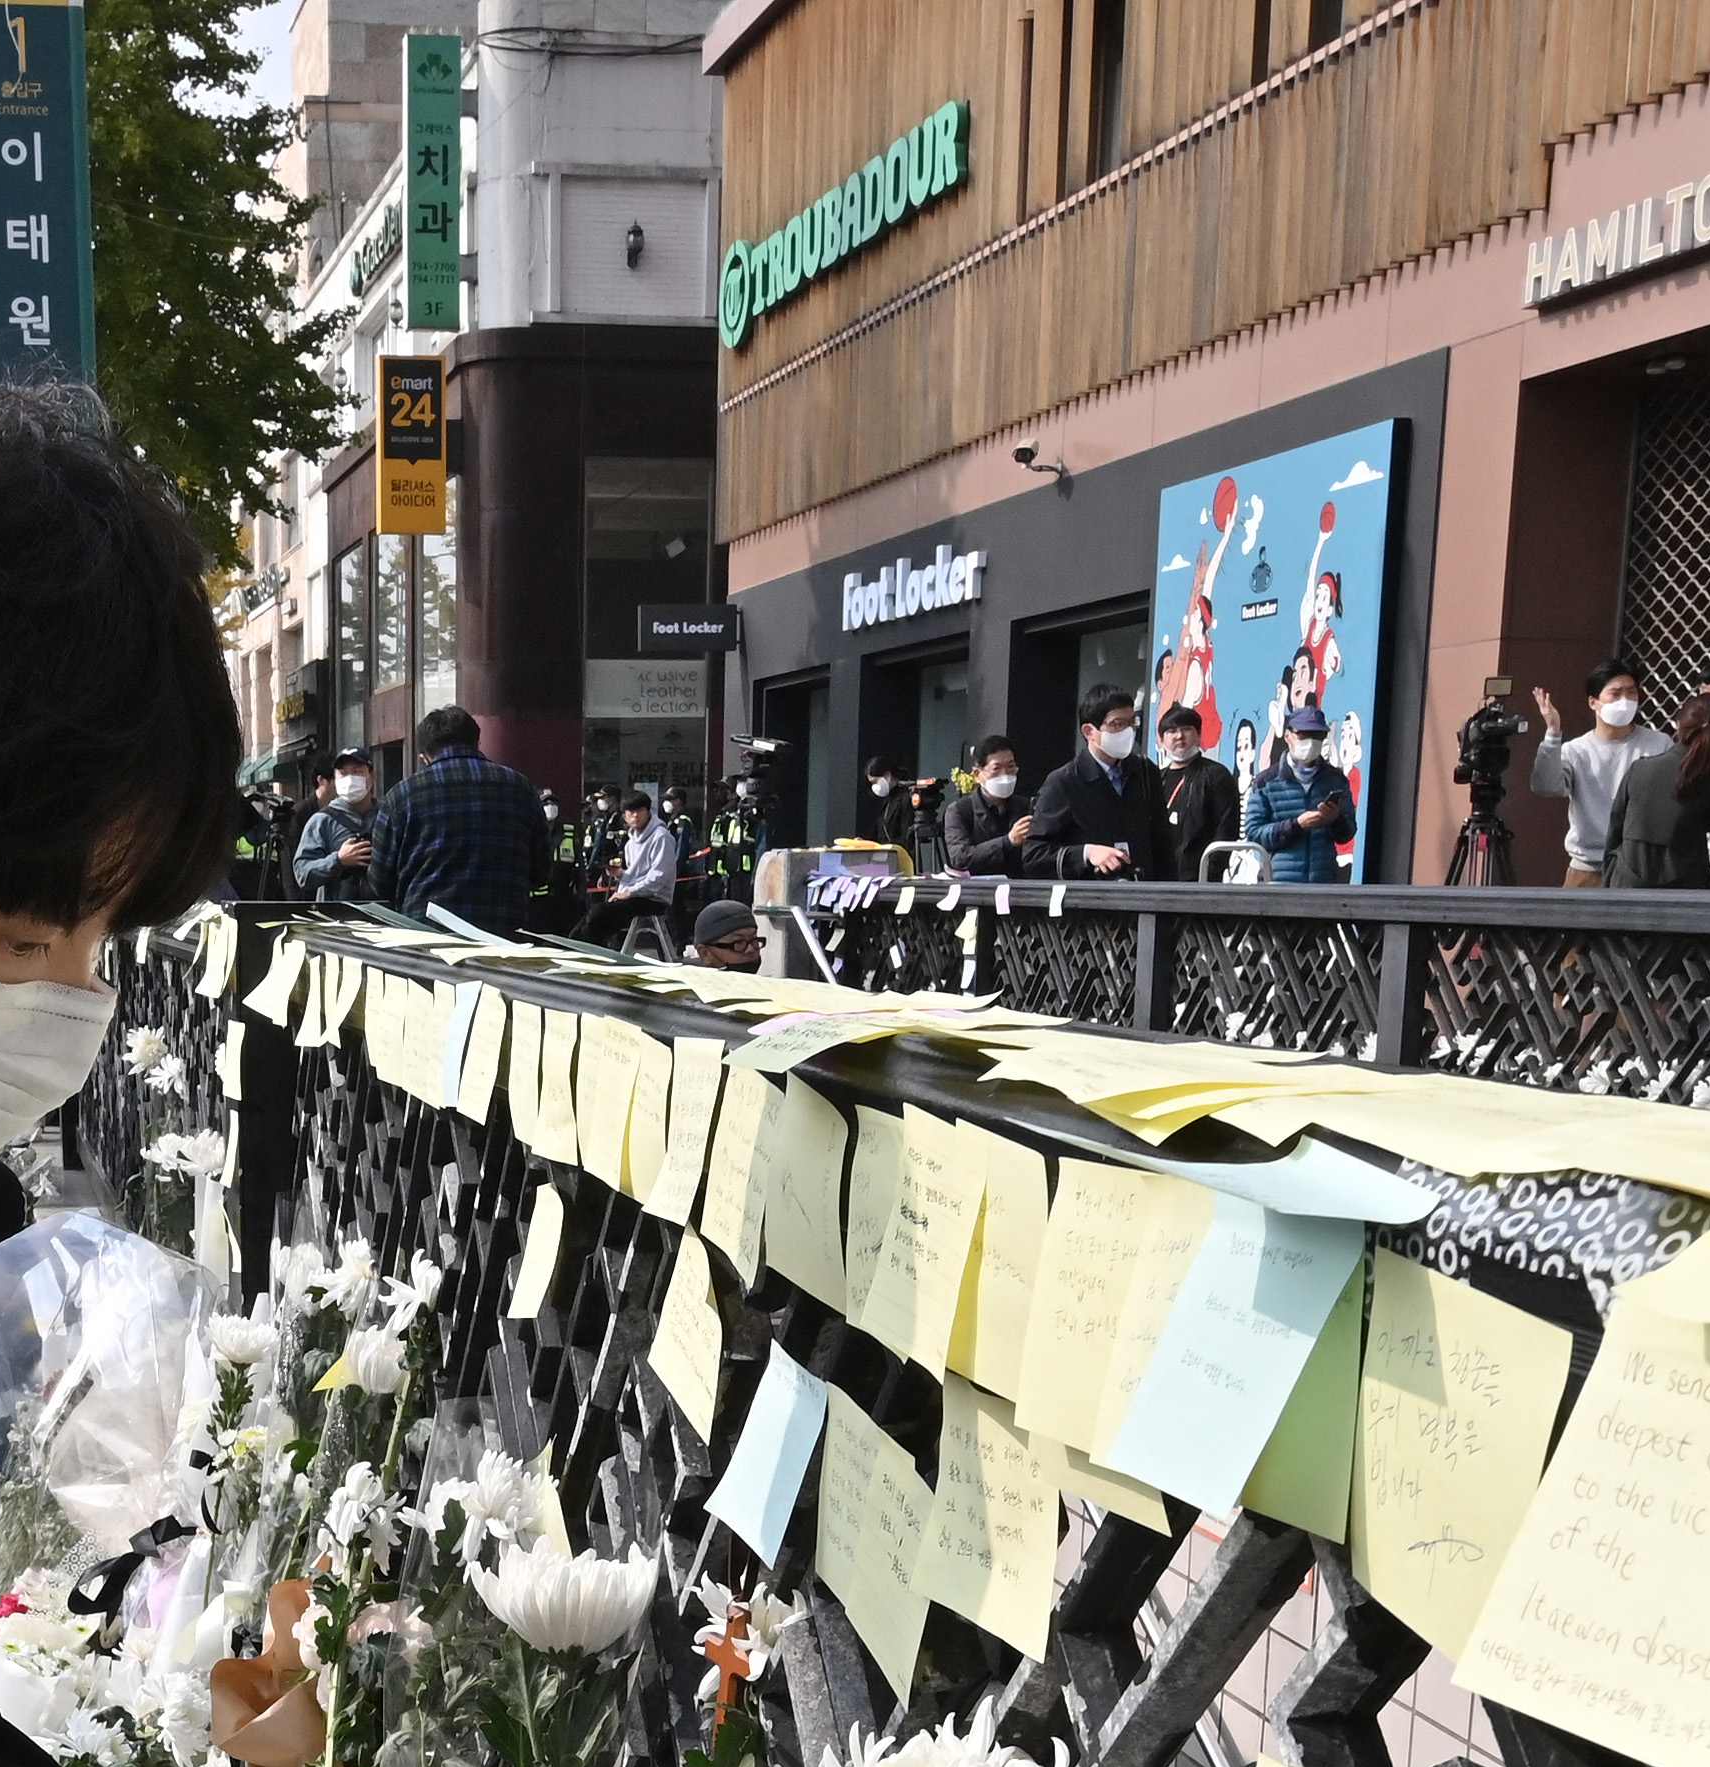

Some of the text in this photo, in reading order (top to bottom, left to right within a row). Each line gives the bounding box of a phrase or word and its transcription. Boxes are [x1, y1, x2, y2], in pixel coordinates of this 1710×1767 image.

[11, 16, 27, 73] 1
[415, 143, 454, 243] 치과
[750, 100, 966, 317] TROUBADOUR
[0, 131, 51, 347] 이태원
[423, 301, 445, 317] 3F
[391, 375, 434, 391] emart
[391, 392, 436, 428] 24
[391, 494, 436, 508] 아이디어
[841, 544, 987, 632] Foot Locker
[652, 621, 725, 635] Foot Locker
[1622, 1350, 1656, 1386] We
[1417, 1407, 1482, 1474] 명복을
[1596, 1398, 1700, 1466] deepest
[1572, 1471, 1601, 1501] to
[1614, 1482, 1652, 1519] the
[1548, 1516, 1638, 1583] of the
[1520, 1581, 1621, 1656] Itaewon
